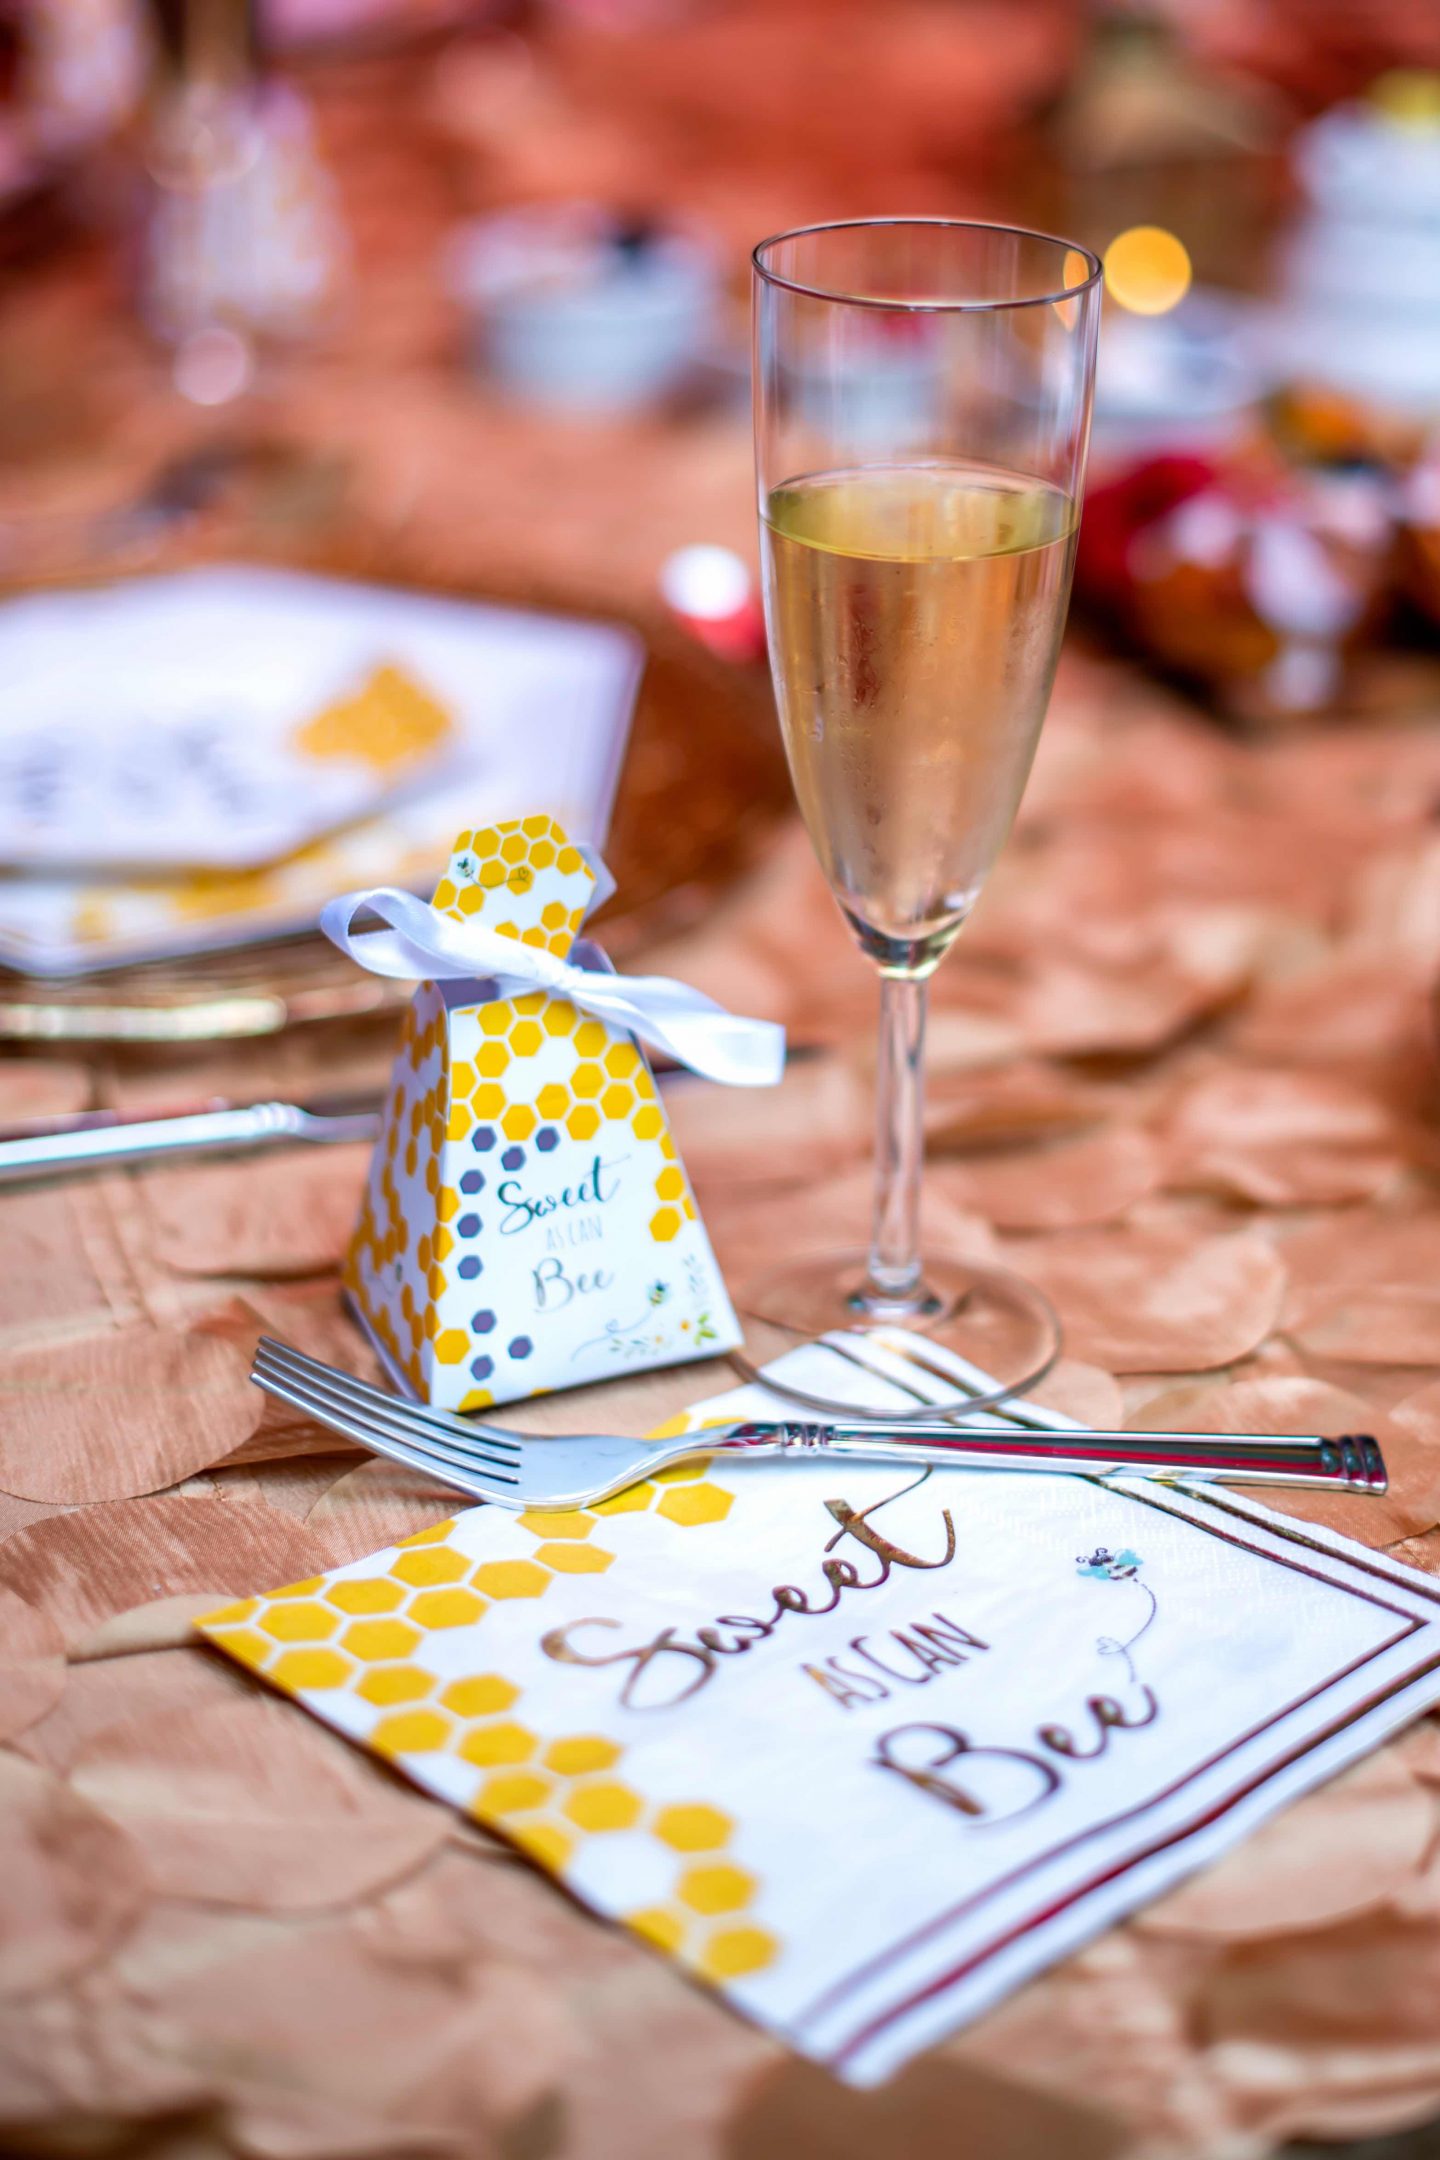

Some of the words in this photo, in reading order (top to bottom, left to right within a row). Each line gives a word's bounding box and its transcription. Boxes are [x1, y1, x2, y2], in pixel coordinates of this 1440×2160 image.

[498, 1155, 631, 1235] Sweet
[532, 1257, 614, 1314] Bee
[540, 1463, 956, 1711] Sweet
[871, 1684, 1158, 1829] Bee
